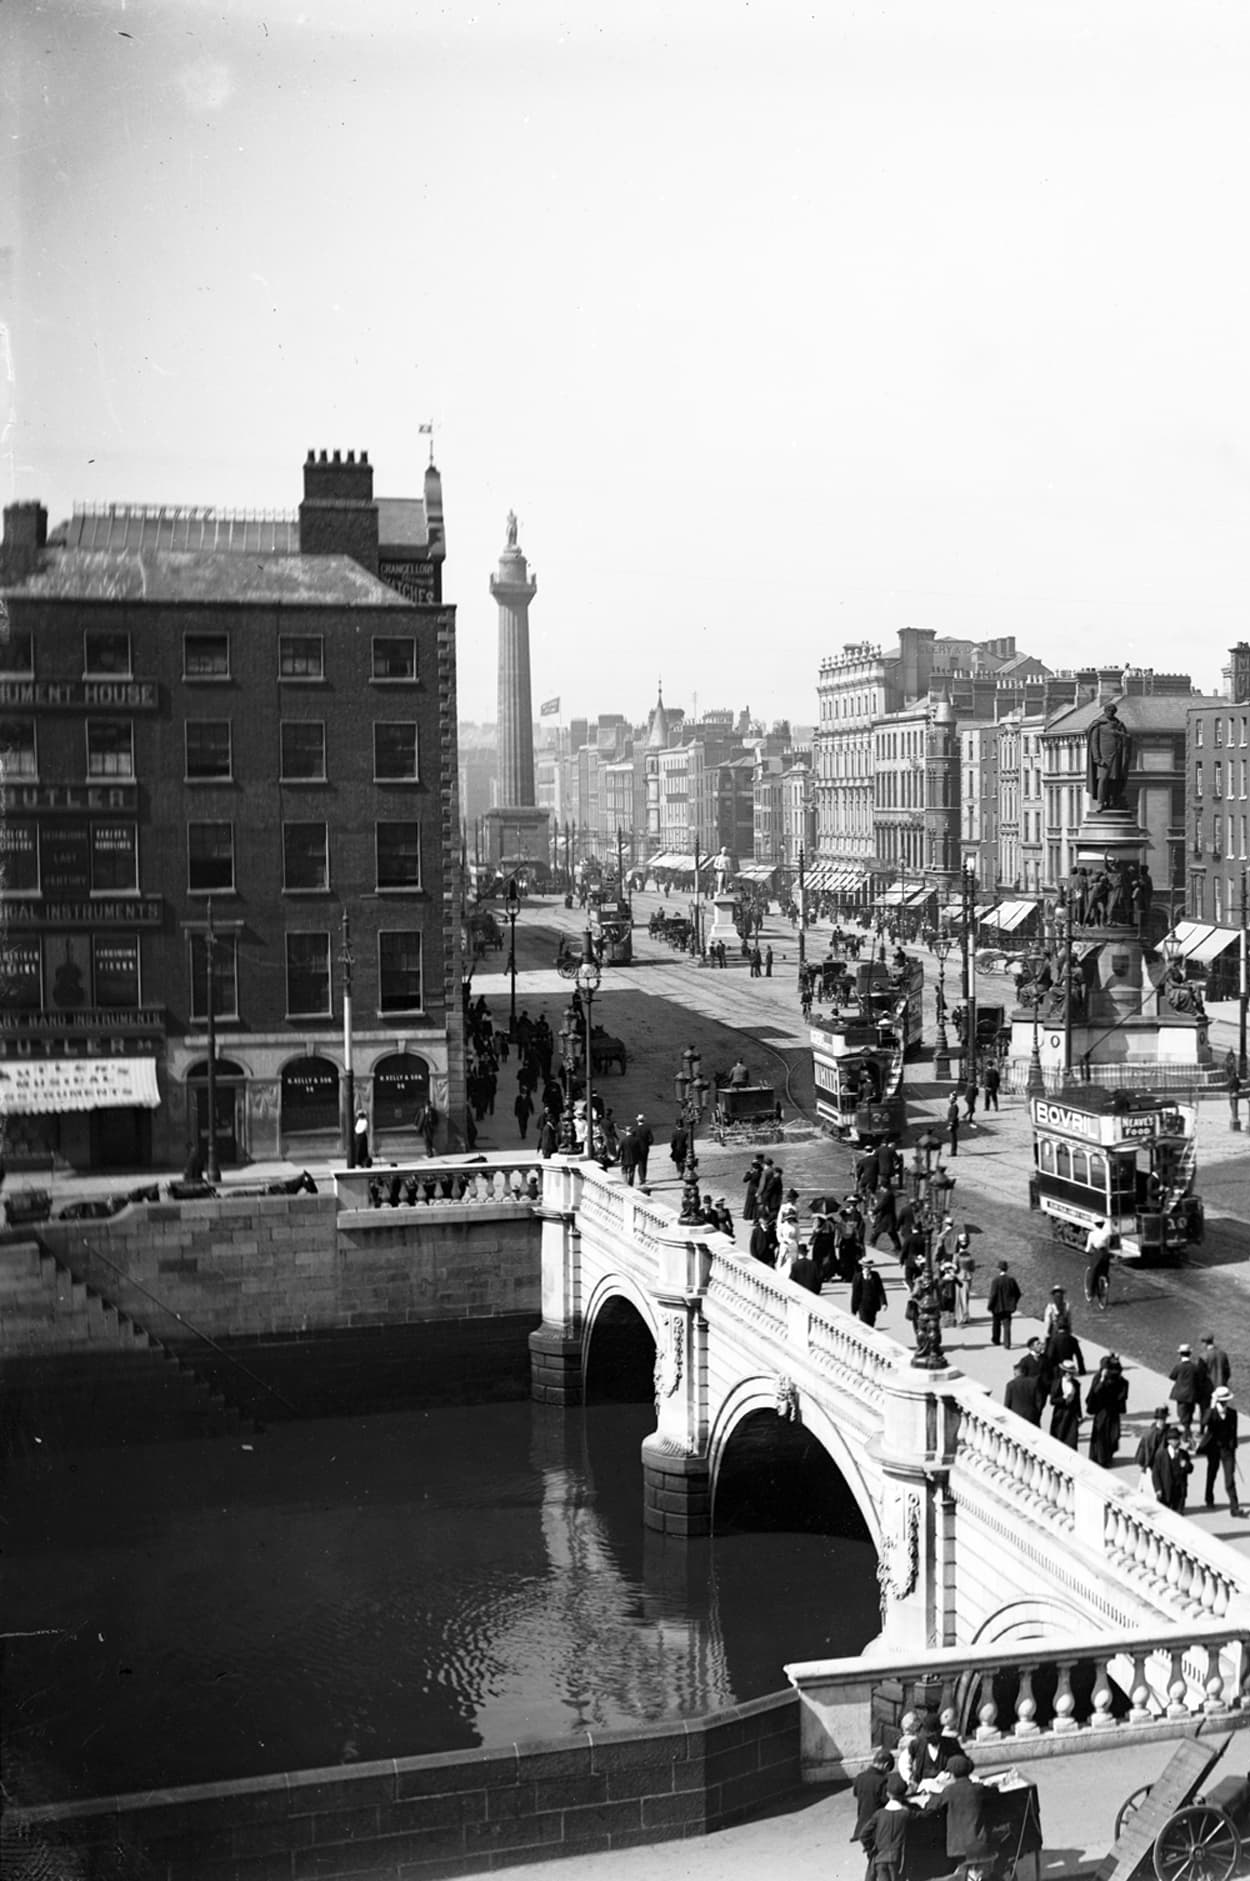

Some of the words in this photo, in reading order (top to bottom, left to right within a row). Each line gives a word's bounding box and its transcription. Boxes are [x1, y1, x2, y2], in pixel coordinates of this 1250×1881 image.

[84, 684, 153, 705] HOUSE
[46, 903, 159, 921] INSTRUMENTS
[1036, 1101, 1099, 1140] BOVRIL
[1122, 1115, 1154, 1128] NEAVE'S
